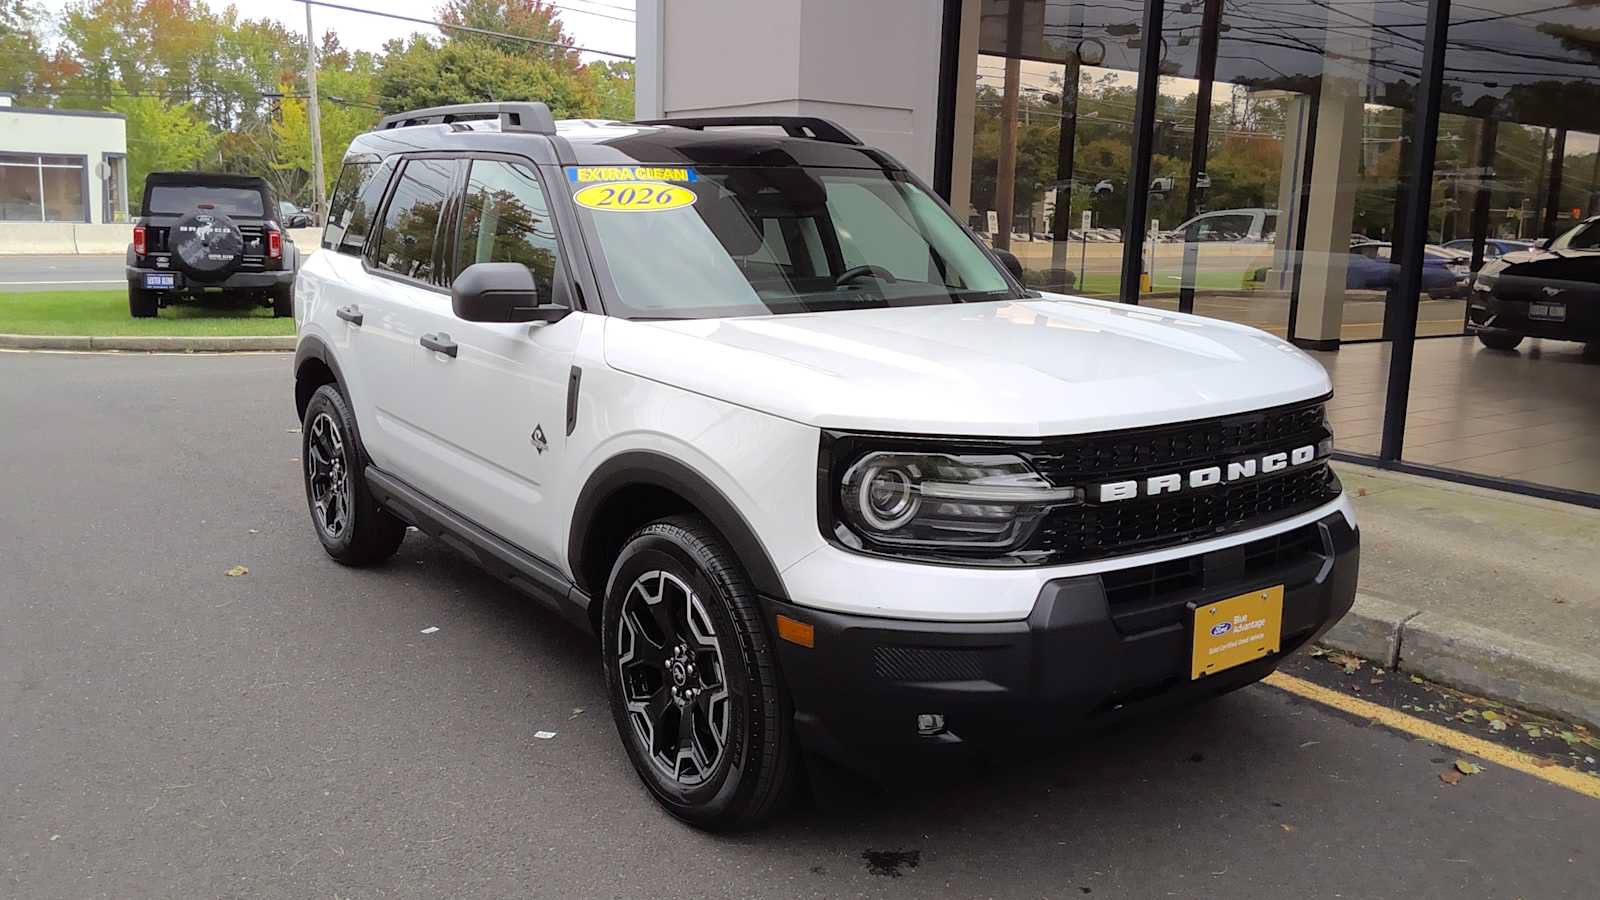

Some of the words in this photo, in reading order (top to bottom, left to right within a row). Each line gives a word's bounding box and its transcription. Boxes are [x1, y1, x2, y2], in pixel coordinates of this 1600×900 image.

[577, 168, 633, 182] EXTRA
[635, 168, 688, 181] CLEAN
[597, 187, 673, 206] 2026
[1100, 444, 1315, 503] BRONCO
